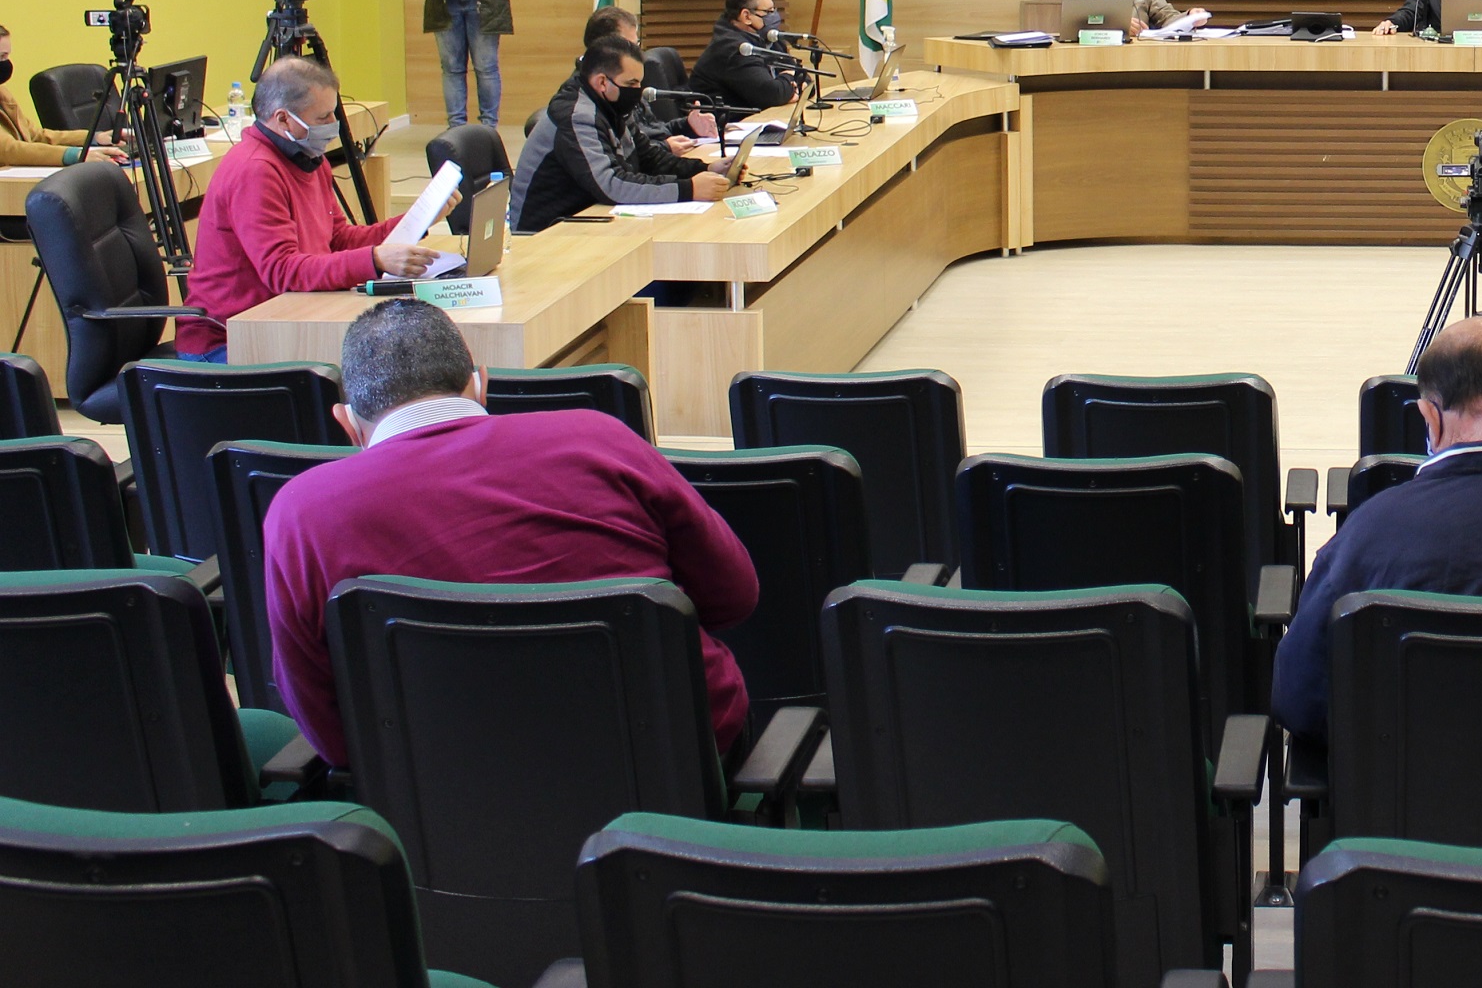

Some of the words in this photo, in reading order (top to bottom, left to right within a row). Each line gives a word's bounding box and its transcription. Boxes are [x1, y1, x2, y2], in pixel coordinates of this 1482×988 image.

[794, 150, 836, 158] POLAZZO
[731, 198, 757, 208] RODRI
[434, 290, 484, 300] DALCHIAVAN
